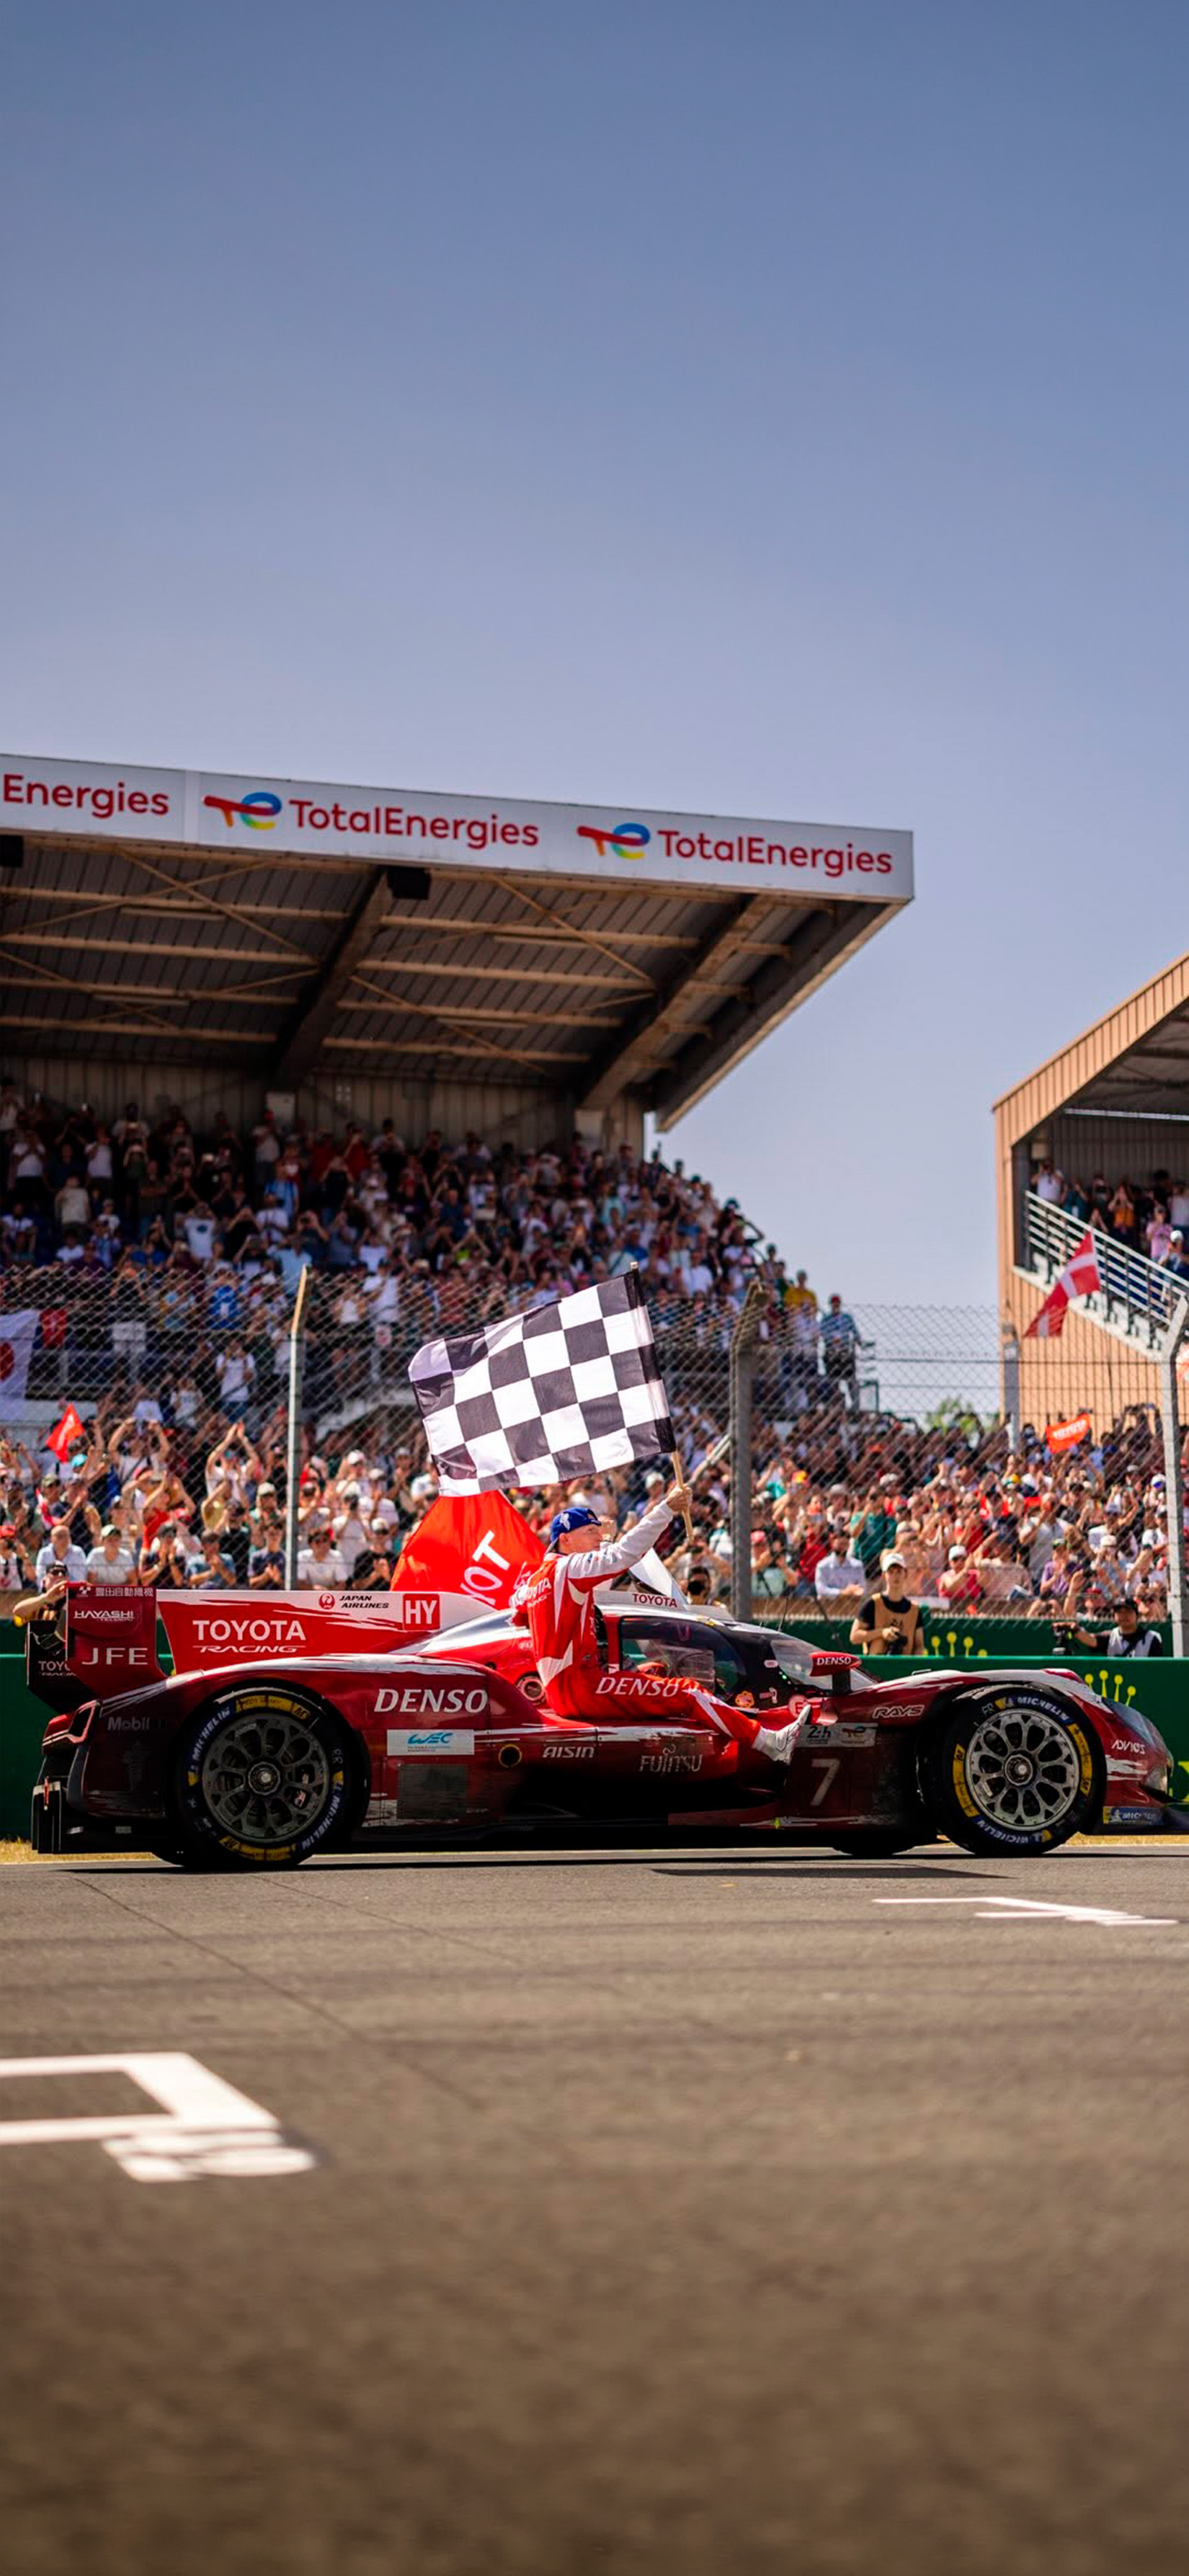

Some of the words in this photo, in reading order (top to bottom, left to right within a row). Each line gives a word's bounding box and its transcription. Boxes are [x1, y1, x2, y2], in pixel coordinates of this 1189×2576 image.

[3, 773, 169, 819] Energies
[289, 799, 539, 849] TotalEnergies
[658, 830, 892, 877] TotalEnergies
[633, 1594, 677, 1607] TOYOTA
[74, 1610, 135, 1619] HAYASHI
[405, 1600, 437, 1624] HY
[192, 1620, 306, 1641] TOYOTA
[82, 1648, 148, 1665] JFE
[816, 1657, 851, 1666] DENSO
[595, 1677, 679, 1697] DENSO
[374, 1689, 488, 1713] DENSO
[1017, 1697, 1069, 1720] MICHELIN
[873, 1705, 925, 1719] RAYS
[108, 1717, 151, 1731] Mobil
[408, 1732, 453, 1744] WEC
[543, 1746, 594, 1758] AISIN
[810, 1759, 840, 1805] 7
